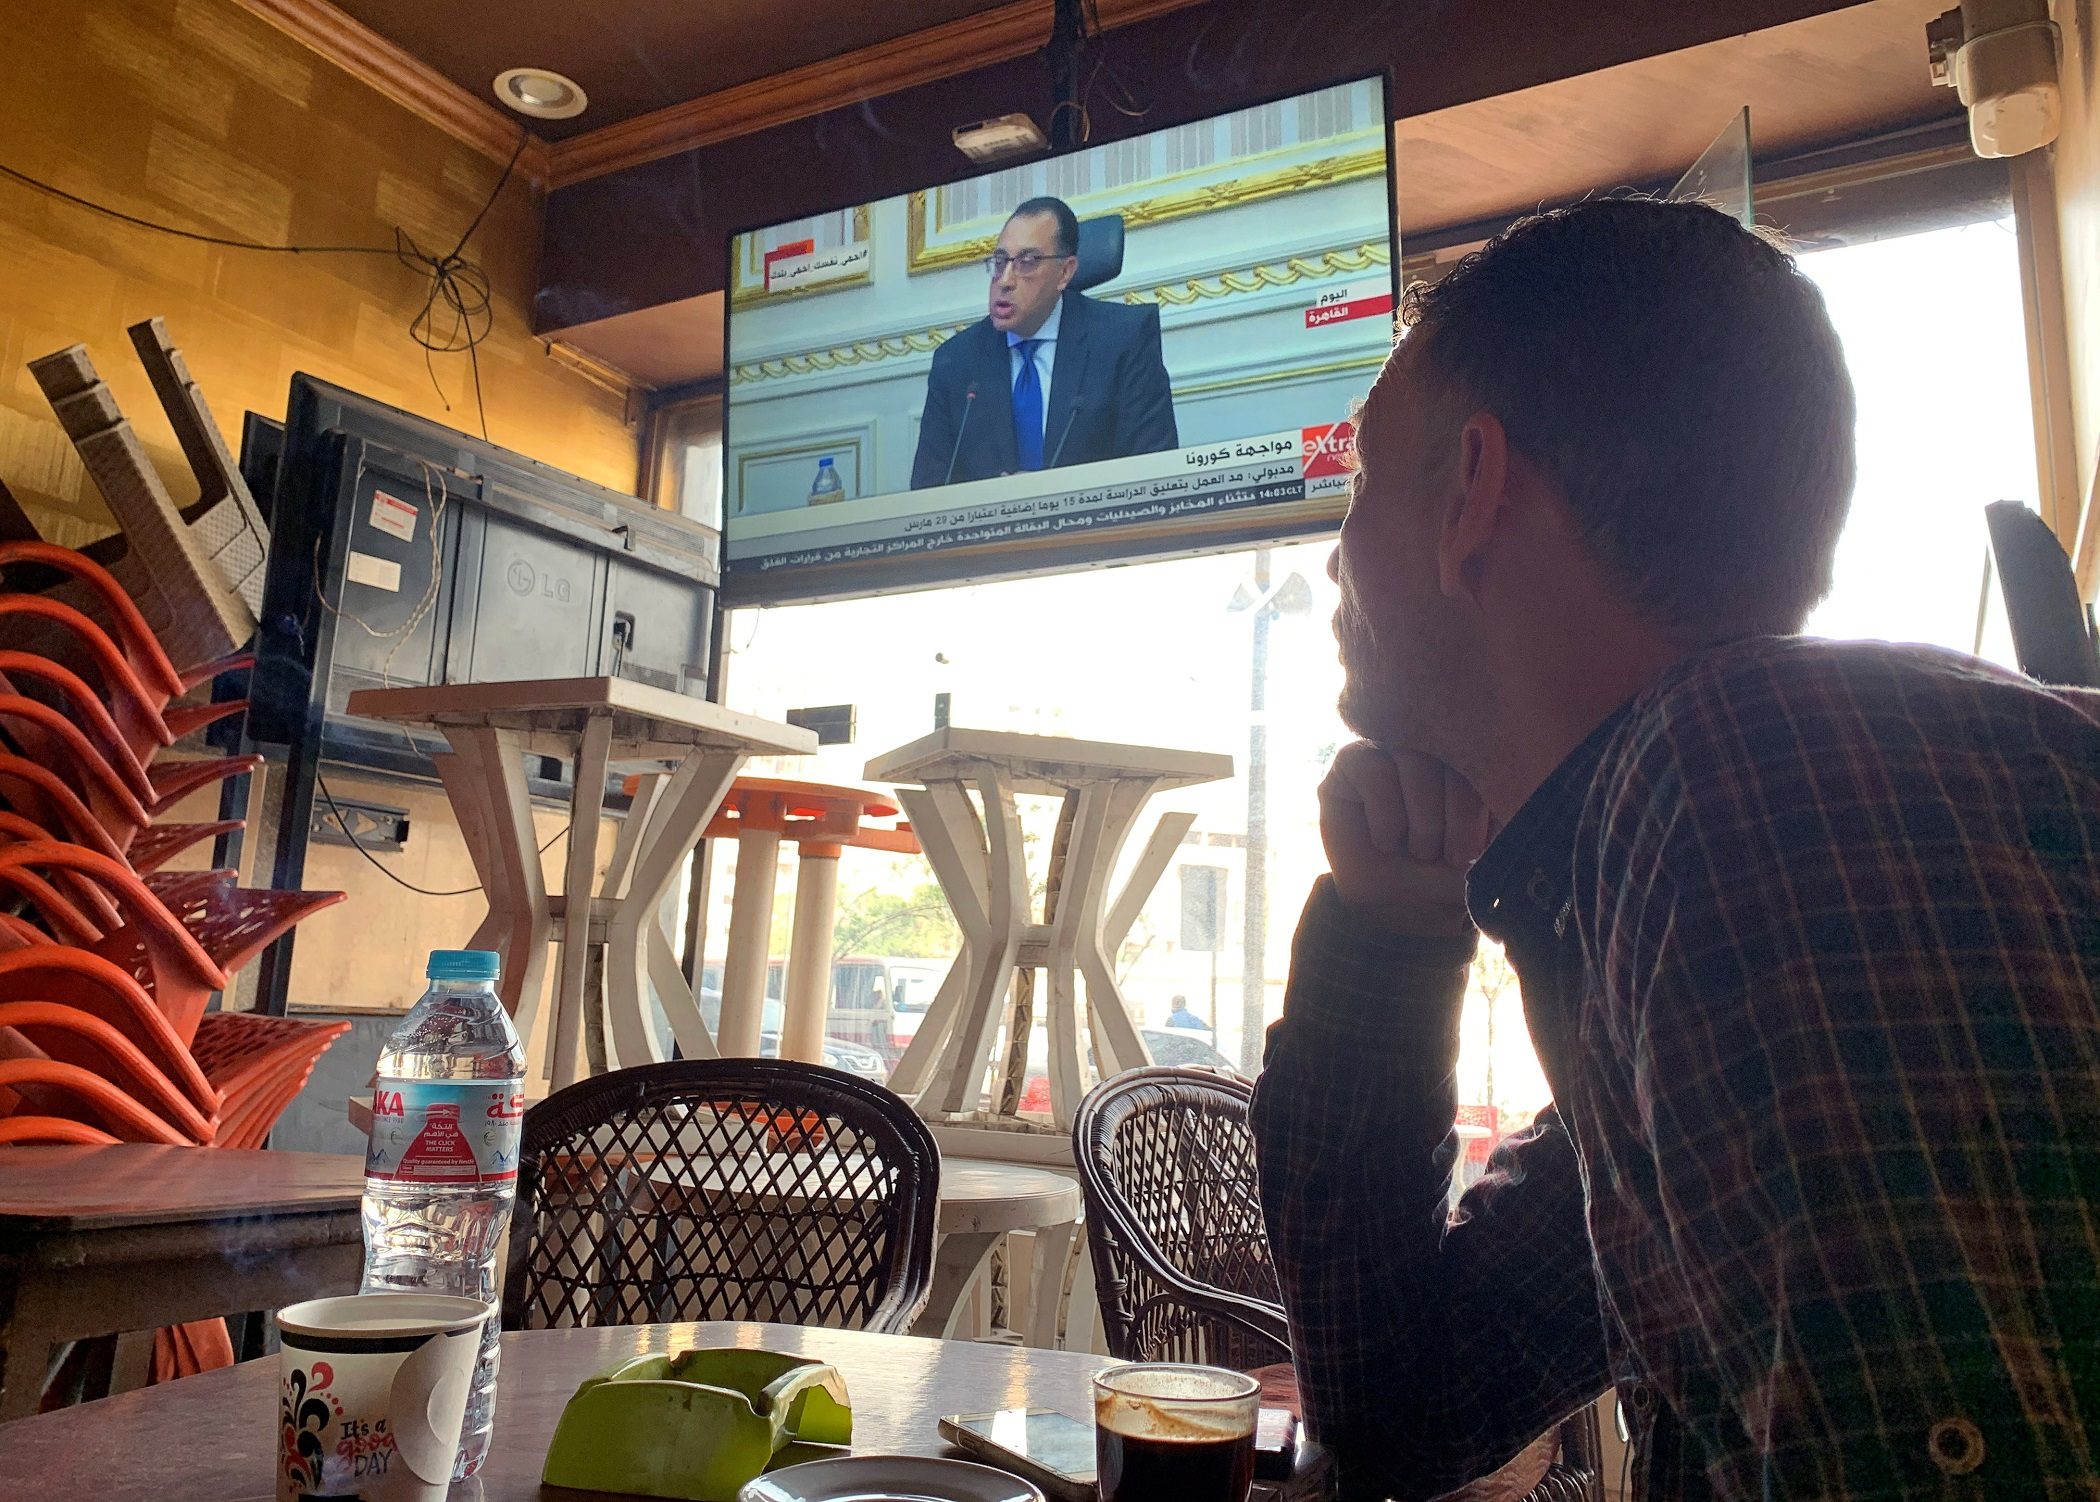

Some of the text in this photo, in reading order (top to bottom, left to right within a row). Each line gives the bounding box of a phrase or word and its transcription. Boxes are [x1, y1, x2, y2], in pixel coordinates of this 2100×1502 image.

[1320, 289, 1348, 305] اليوم
[1308, 307, 1348, 324] القاهرة
[1186, 440, 1292, 466] مواجهة كورونا
[1192, 474, 1224, 490] العمل
[1228, 473, 1243, 482] مد
[1106, 485, 1146, 501] الدراسة
[1150, 480, 1188, 497] بتعليق
[1064, 496, 1075, 507] 15
[1079, 492, 1103, 504] لمدة
[1169, 497, 1214, 515] المخابز
[1000, 502, 1036, 518] إضافية
[1096, 504, 1166, 523] والصيدليات
[904, 520, 932, 532] مارس
[950, 514, 965, 526] من
[1053, 516, 1093, 531] ومحال
[886, 538, 924, 553] المراكز
[927, 532, 953, 549] خارج
[825, 551, 841, 562] من
[541, 573, 571, 603] LG
[420, 1158, 450, 1166] guaranteed
[375, 1418, 387, 1433] a
[354, 1448, 393, 1477] DAY
